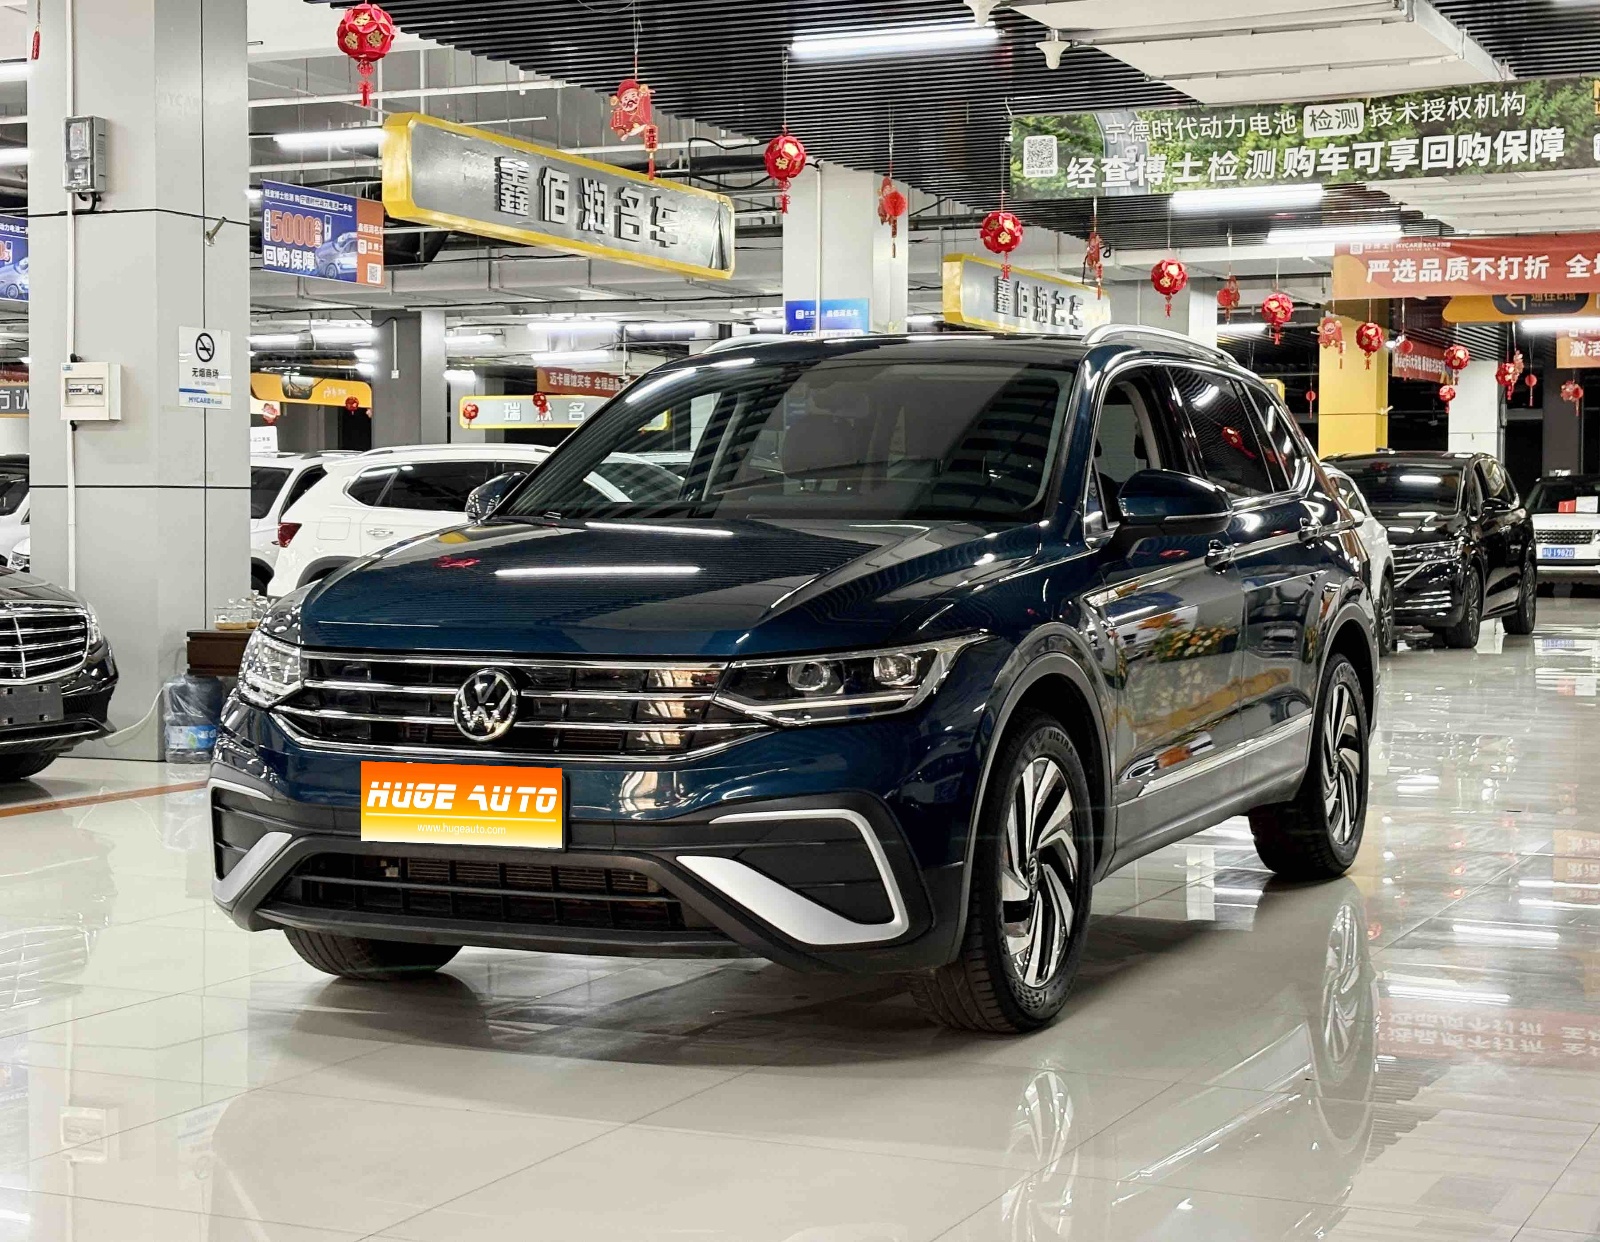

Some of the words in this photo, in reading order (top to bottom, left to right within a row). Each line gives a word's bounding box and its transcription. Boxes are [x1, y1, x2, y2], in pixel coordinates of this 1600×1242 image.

[1104, 111, 1297, 144] 宁德时代动力电池
[1308, 108, 1361, 132] 检测
[1369, 91, 1526, 128] 技术授权机构
[495, 155, 679, 249] 鑫佰润名车
[270, 209, 316, 248] 5000
[263, 244, 316, 272] 回购保障
[1365, 253, 1550, 284] 严选品质不打折
[1569, 340, 1600, 357] 激活
[191, 367, 220, 379] 无烟商场
